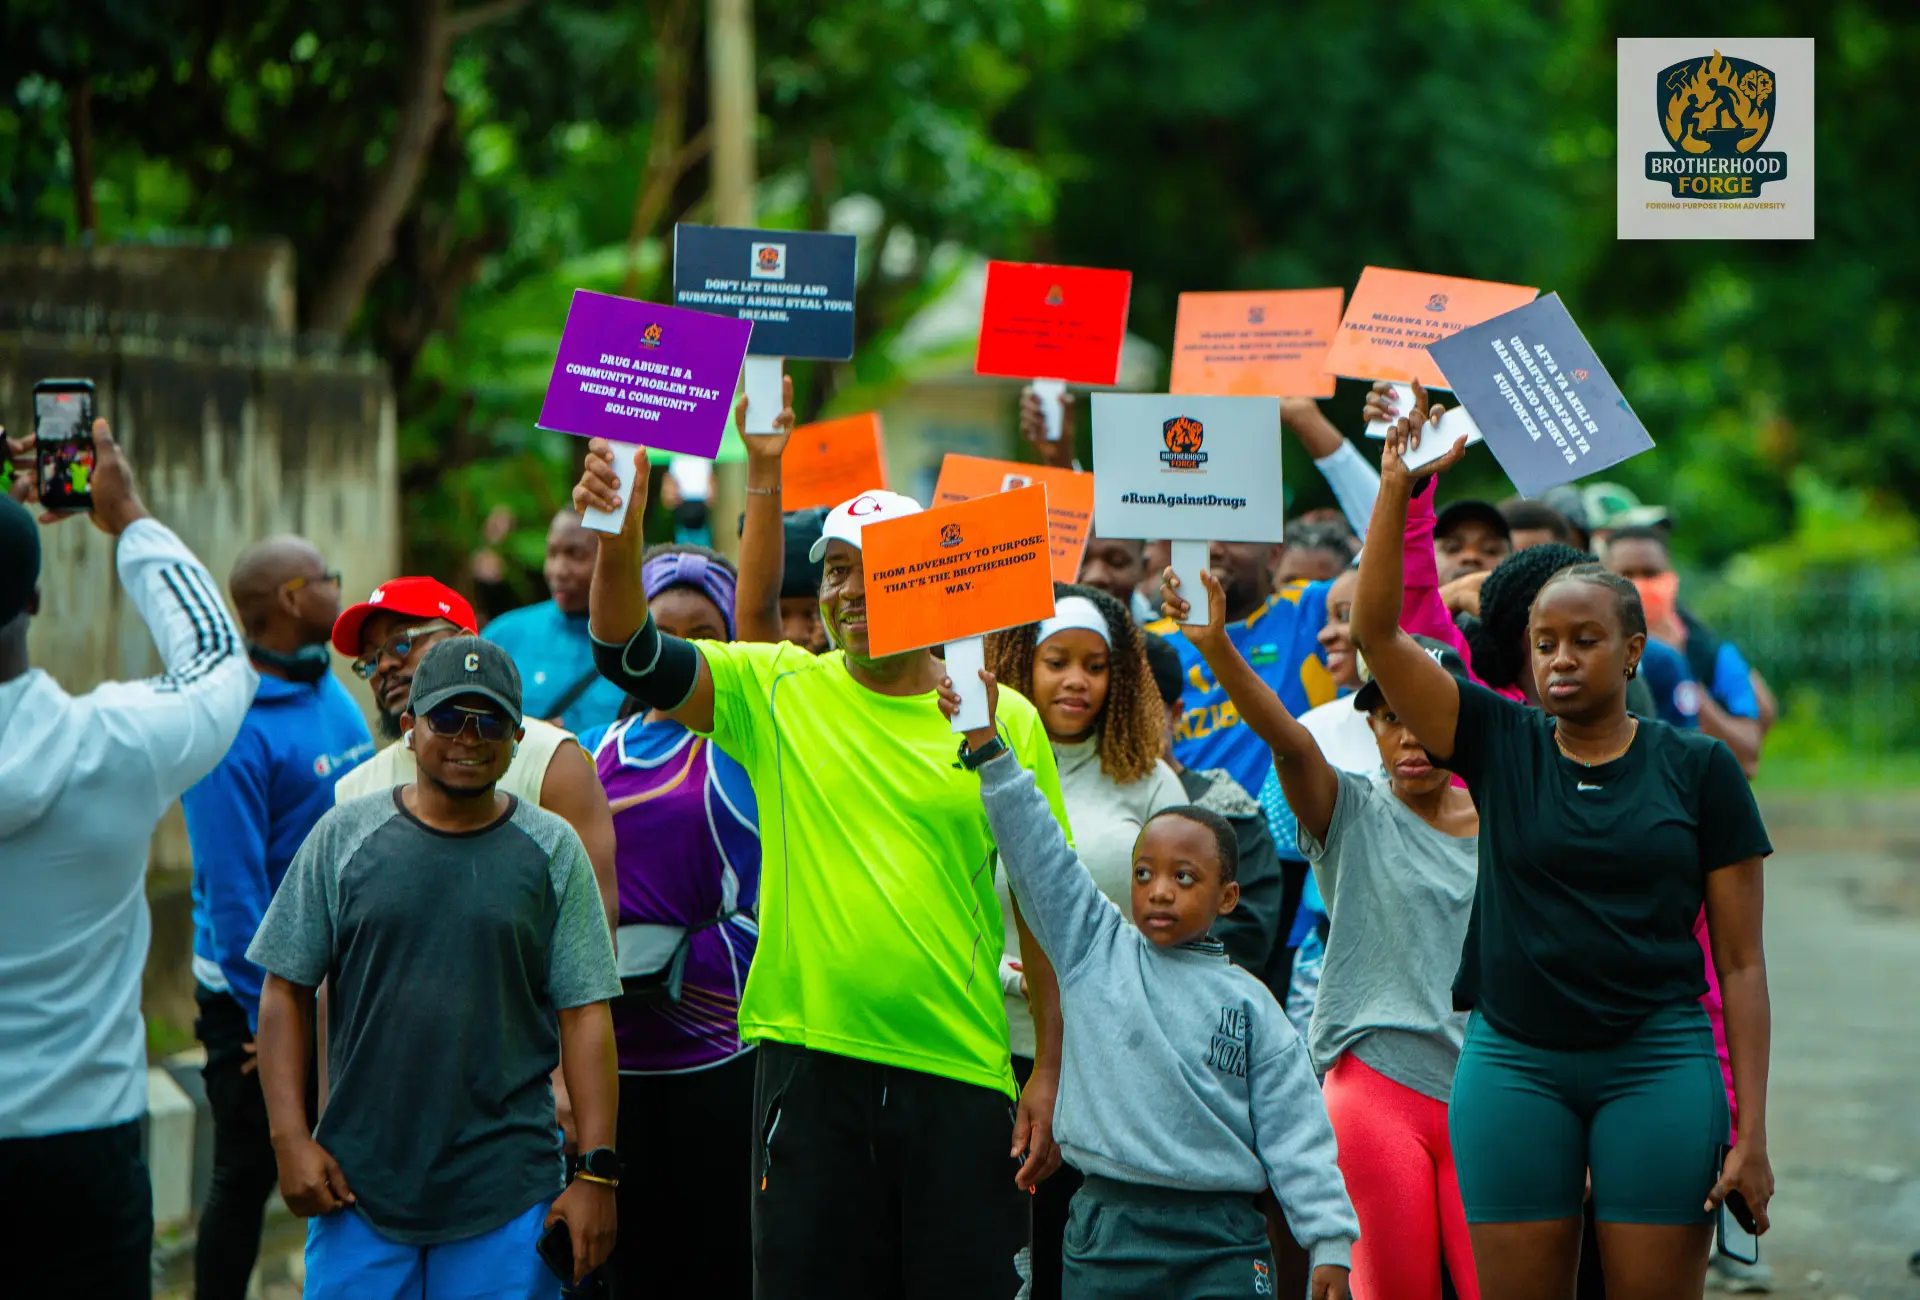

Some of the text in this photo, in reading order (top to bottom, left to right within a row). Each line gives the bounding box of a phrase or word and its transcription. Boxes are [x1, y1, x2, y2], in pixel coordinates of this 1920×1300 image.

[678, 291, 852, 311] SUBSTANCE ABUSE STEAL YOUR
[741, 281, 762, 292] LET
[763, 283, 801, 295] DRUGS
[803, 285, 828, 296] AND
[600, 354, 692, 380] DRUG ABUSE IS A
[566, 363, 719, 400] COMMUNITY PROBLEM THAT
[1534, 344, 1558, 375] AFYA
[1554, 372, 1569, 391] YA
[1564, 391, 1590, 422] AKILI
[1584, 420, 1598, 434] SI
[580, 381, 697, 412] NEEDS A COMMUNITY
[1493, 372, 1541, 442] KUJITOKEZA
[605, 402, 660, 421] SOLUTION
[1535, 405, 1549, 421] NI
[1543, 419, 1567, 447] SIKU
[1562, 445, 1577, 465] YA
[1576, 436, 1590, 455] YA
[1121, 493, 1247, 510] #RunAgainstDrugs
[873, 567, 905, 581] FROM
[908, 551, 971, 574] ADVERSITY
[974, 547, 989, 558] TO
[992, 535, 1045, 554] PURPOSE.
[928, 571, 950, 584] THE
[953, 552, 1036, 578] BROTHERHOOD
[945, 581, 974, 595] WAY.
[464, 653, 479, 673] C
